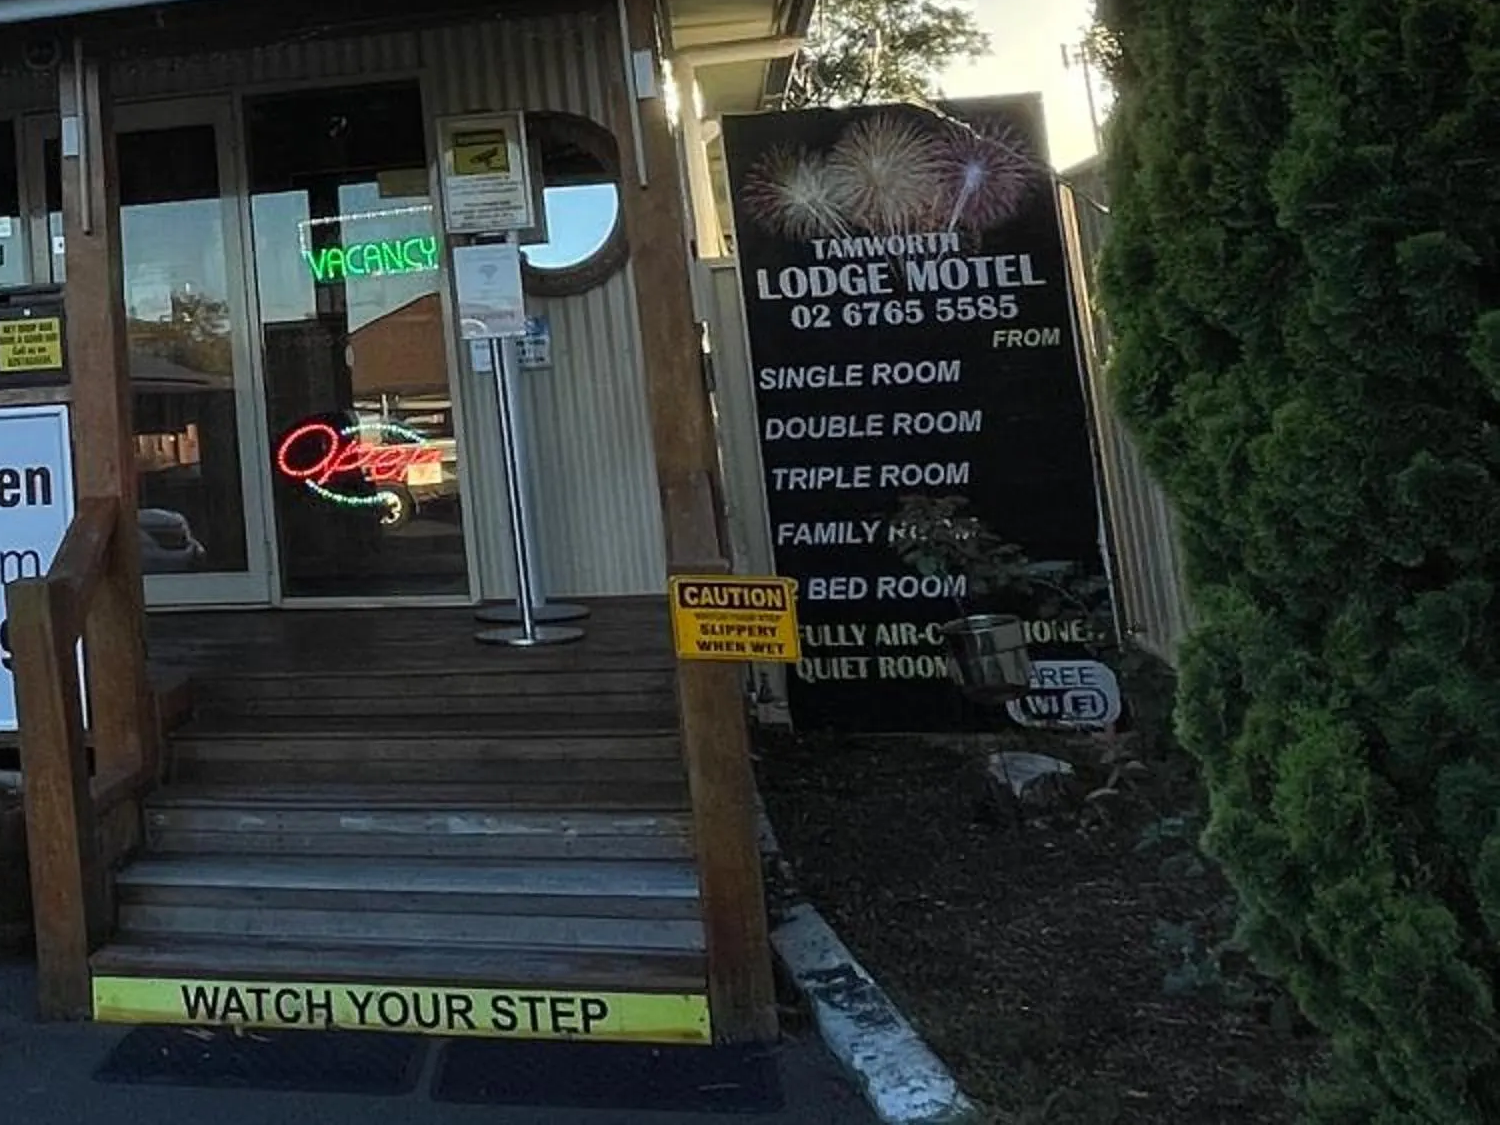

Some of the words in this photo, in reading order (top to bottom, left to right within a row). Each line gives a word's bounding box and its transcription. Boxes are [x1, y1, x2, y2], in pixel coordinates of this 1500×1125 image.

[306, 236, 436, 279] VACANCY
[811, 232, 960, 261] TAMWORTH
[757, 262, 892, 300] LODGE
[907, 254, 1046, 291] MOTEL
[791, 304, 831, 328] 02
[842, 300, 925, 325] 6765
[935, 295, 1019, 321] 5585
[992, 328, 1061, 348] FROM
[759, 364, 863, 390] SINGLE
[871, 360, 961, 385] ROOM
[765, 415, 884, 441] DOUBLE
[893, 410, 982, 435] ROOM
[771, 467, 871, 491] TRIPLE
[880, 463, 969, 487] ROOM
[777, 520, 882, 546] FAMILY
[683, 585, 783, 608] CAUTION
[808, 577, 868, 600] BED
[876, 575, 967, 599] ROOM
[695, 639, 746, 652] WHEN
[796, 657, 871, 683] QUIET
[181, 984, 332, 1024] WATCH
[346, 989, 475, 1031] YOUR
[490, 993, 608, 1035] STEP
